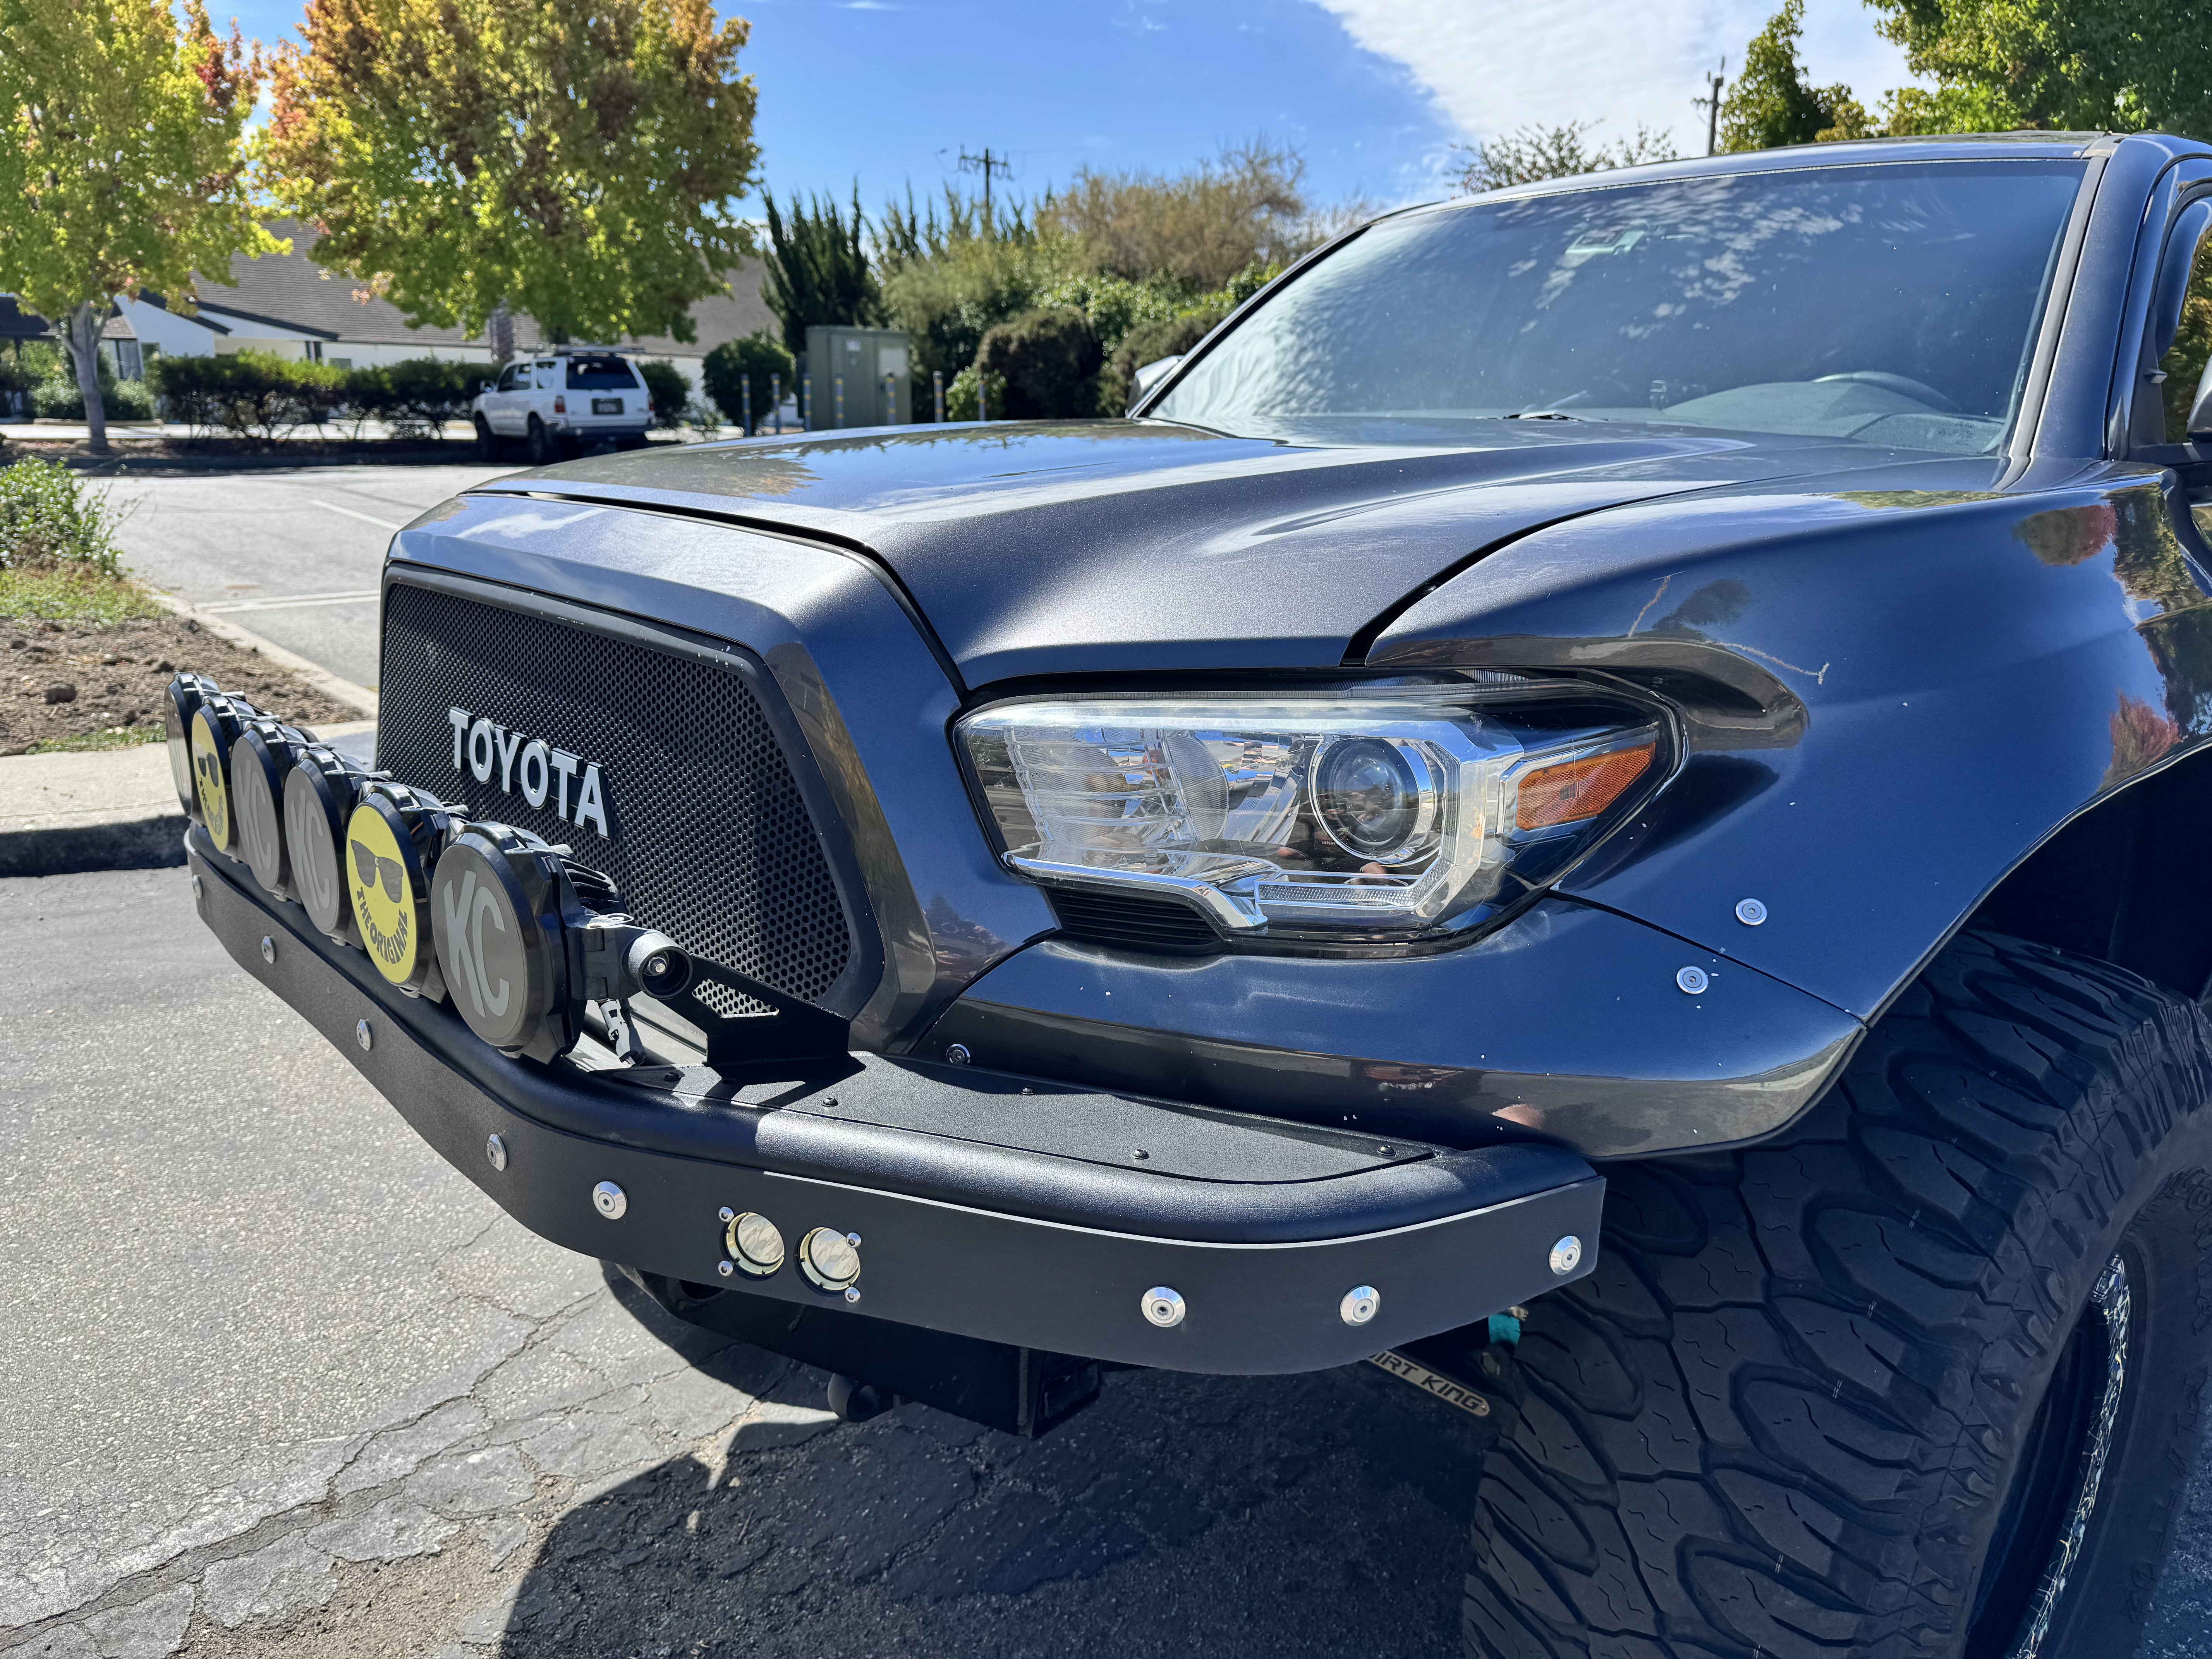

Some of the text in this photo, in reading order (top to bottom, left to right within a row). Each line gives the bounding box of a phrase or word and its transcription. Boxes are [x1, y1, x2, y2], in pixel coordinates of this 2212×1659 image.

[237, 758, 271, 871] KC
[449, 706, 609, 839] TOYOTA
[290, 789, 331, 911] KC
[357, 886, 407, 964] THE ORIGINAL
[443, 870, 510, 1018] KC
[1369, 1352, 1483, 1410] IRT KING
